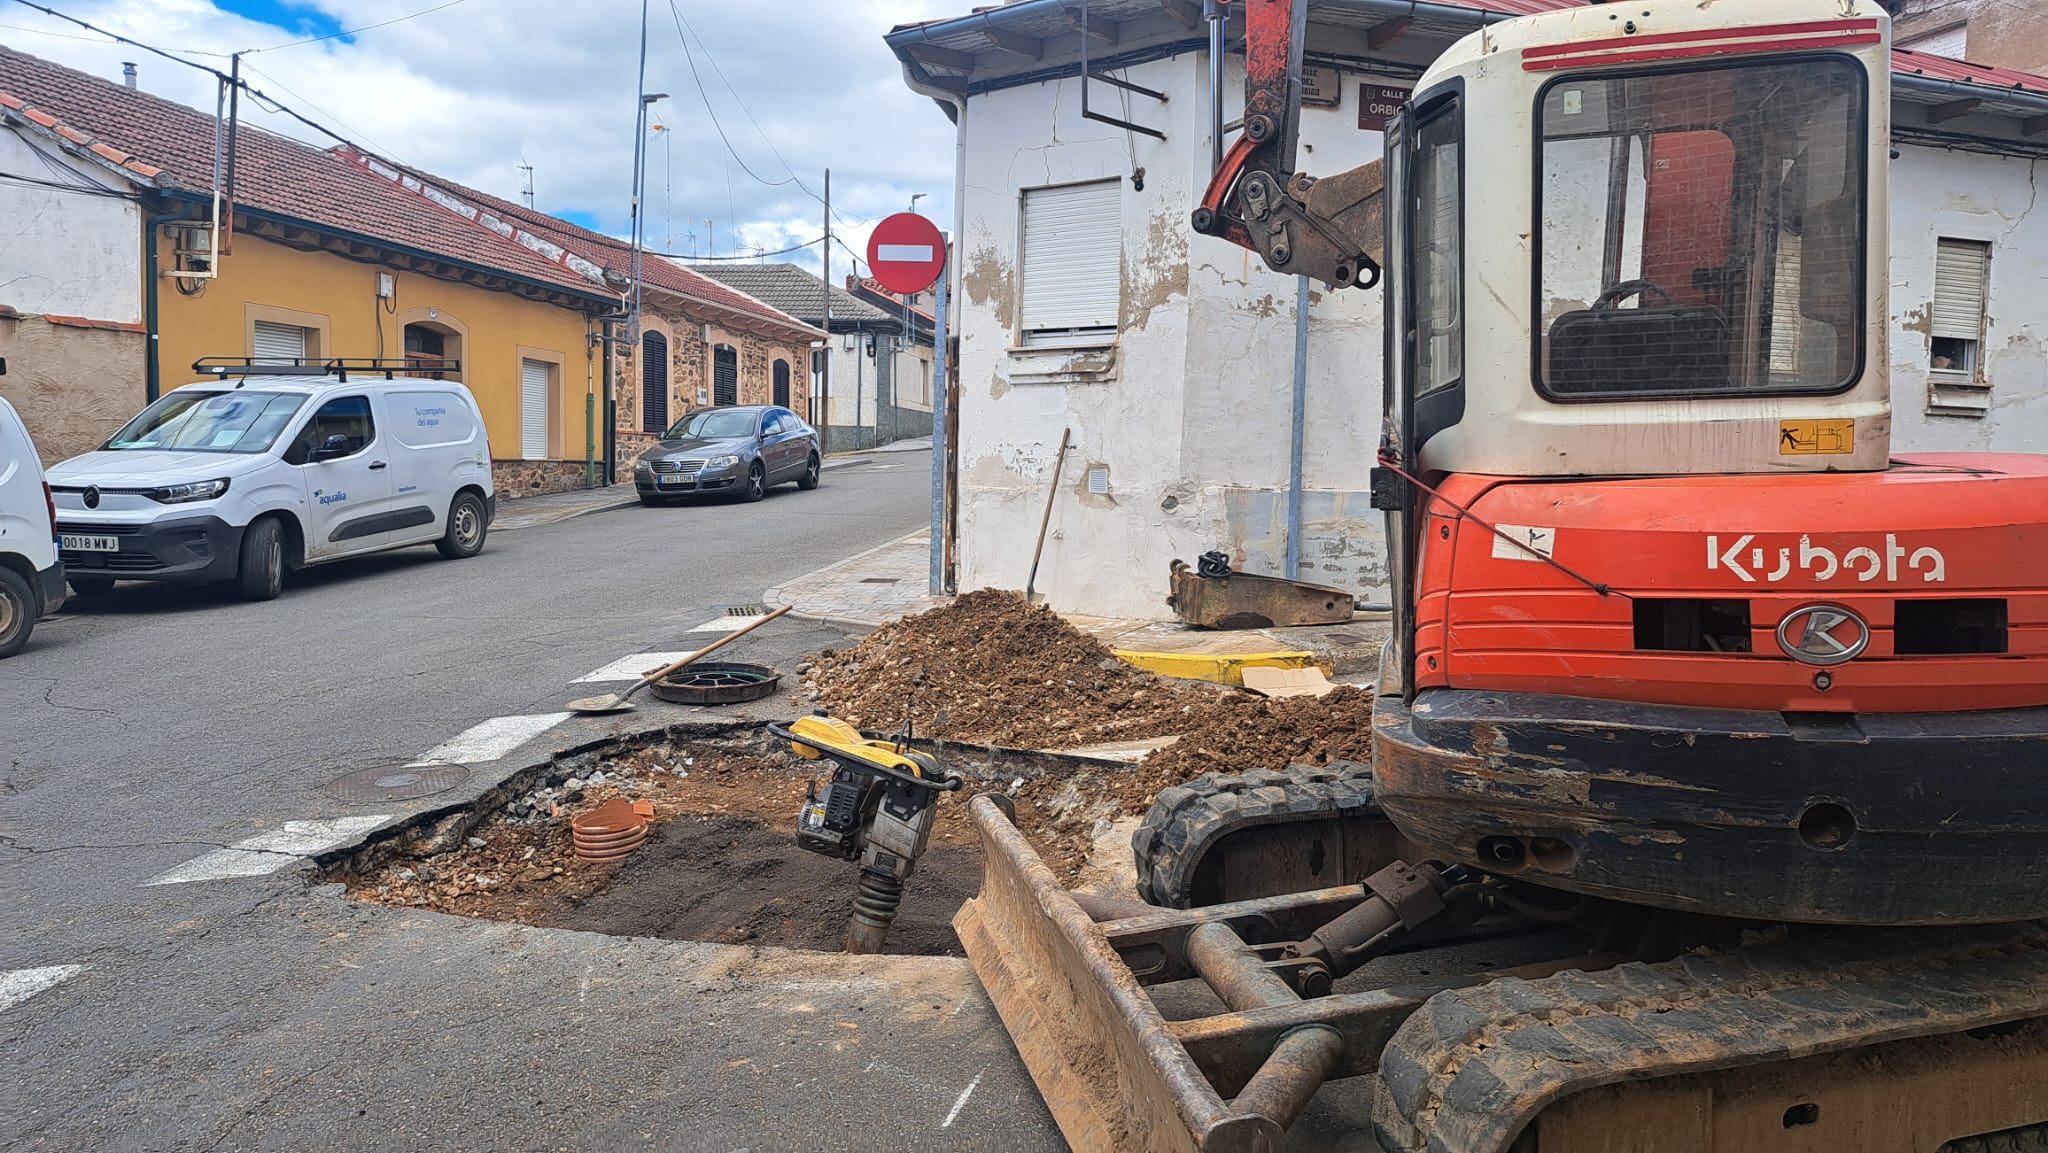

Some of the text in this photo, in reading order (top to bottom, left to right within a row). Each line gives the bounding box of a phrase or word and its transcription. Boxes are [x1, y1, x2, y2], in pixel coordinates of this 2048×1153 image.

[1302, 67, 1317, 77] ALLE
[1381, 90, 1403, 99] CALLE
[319, 490, 347, 506] aqualia
[64, 537, 115, 550] 0018 MWJ
[1706, 534, 1945, 582] Kubota
